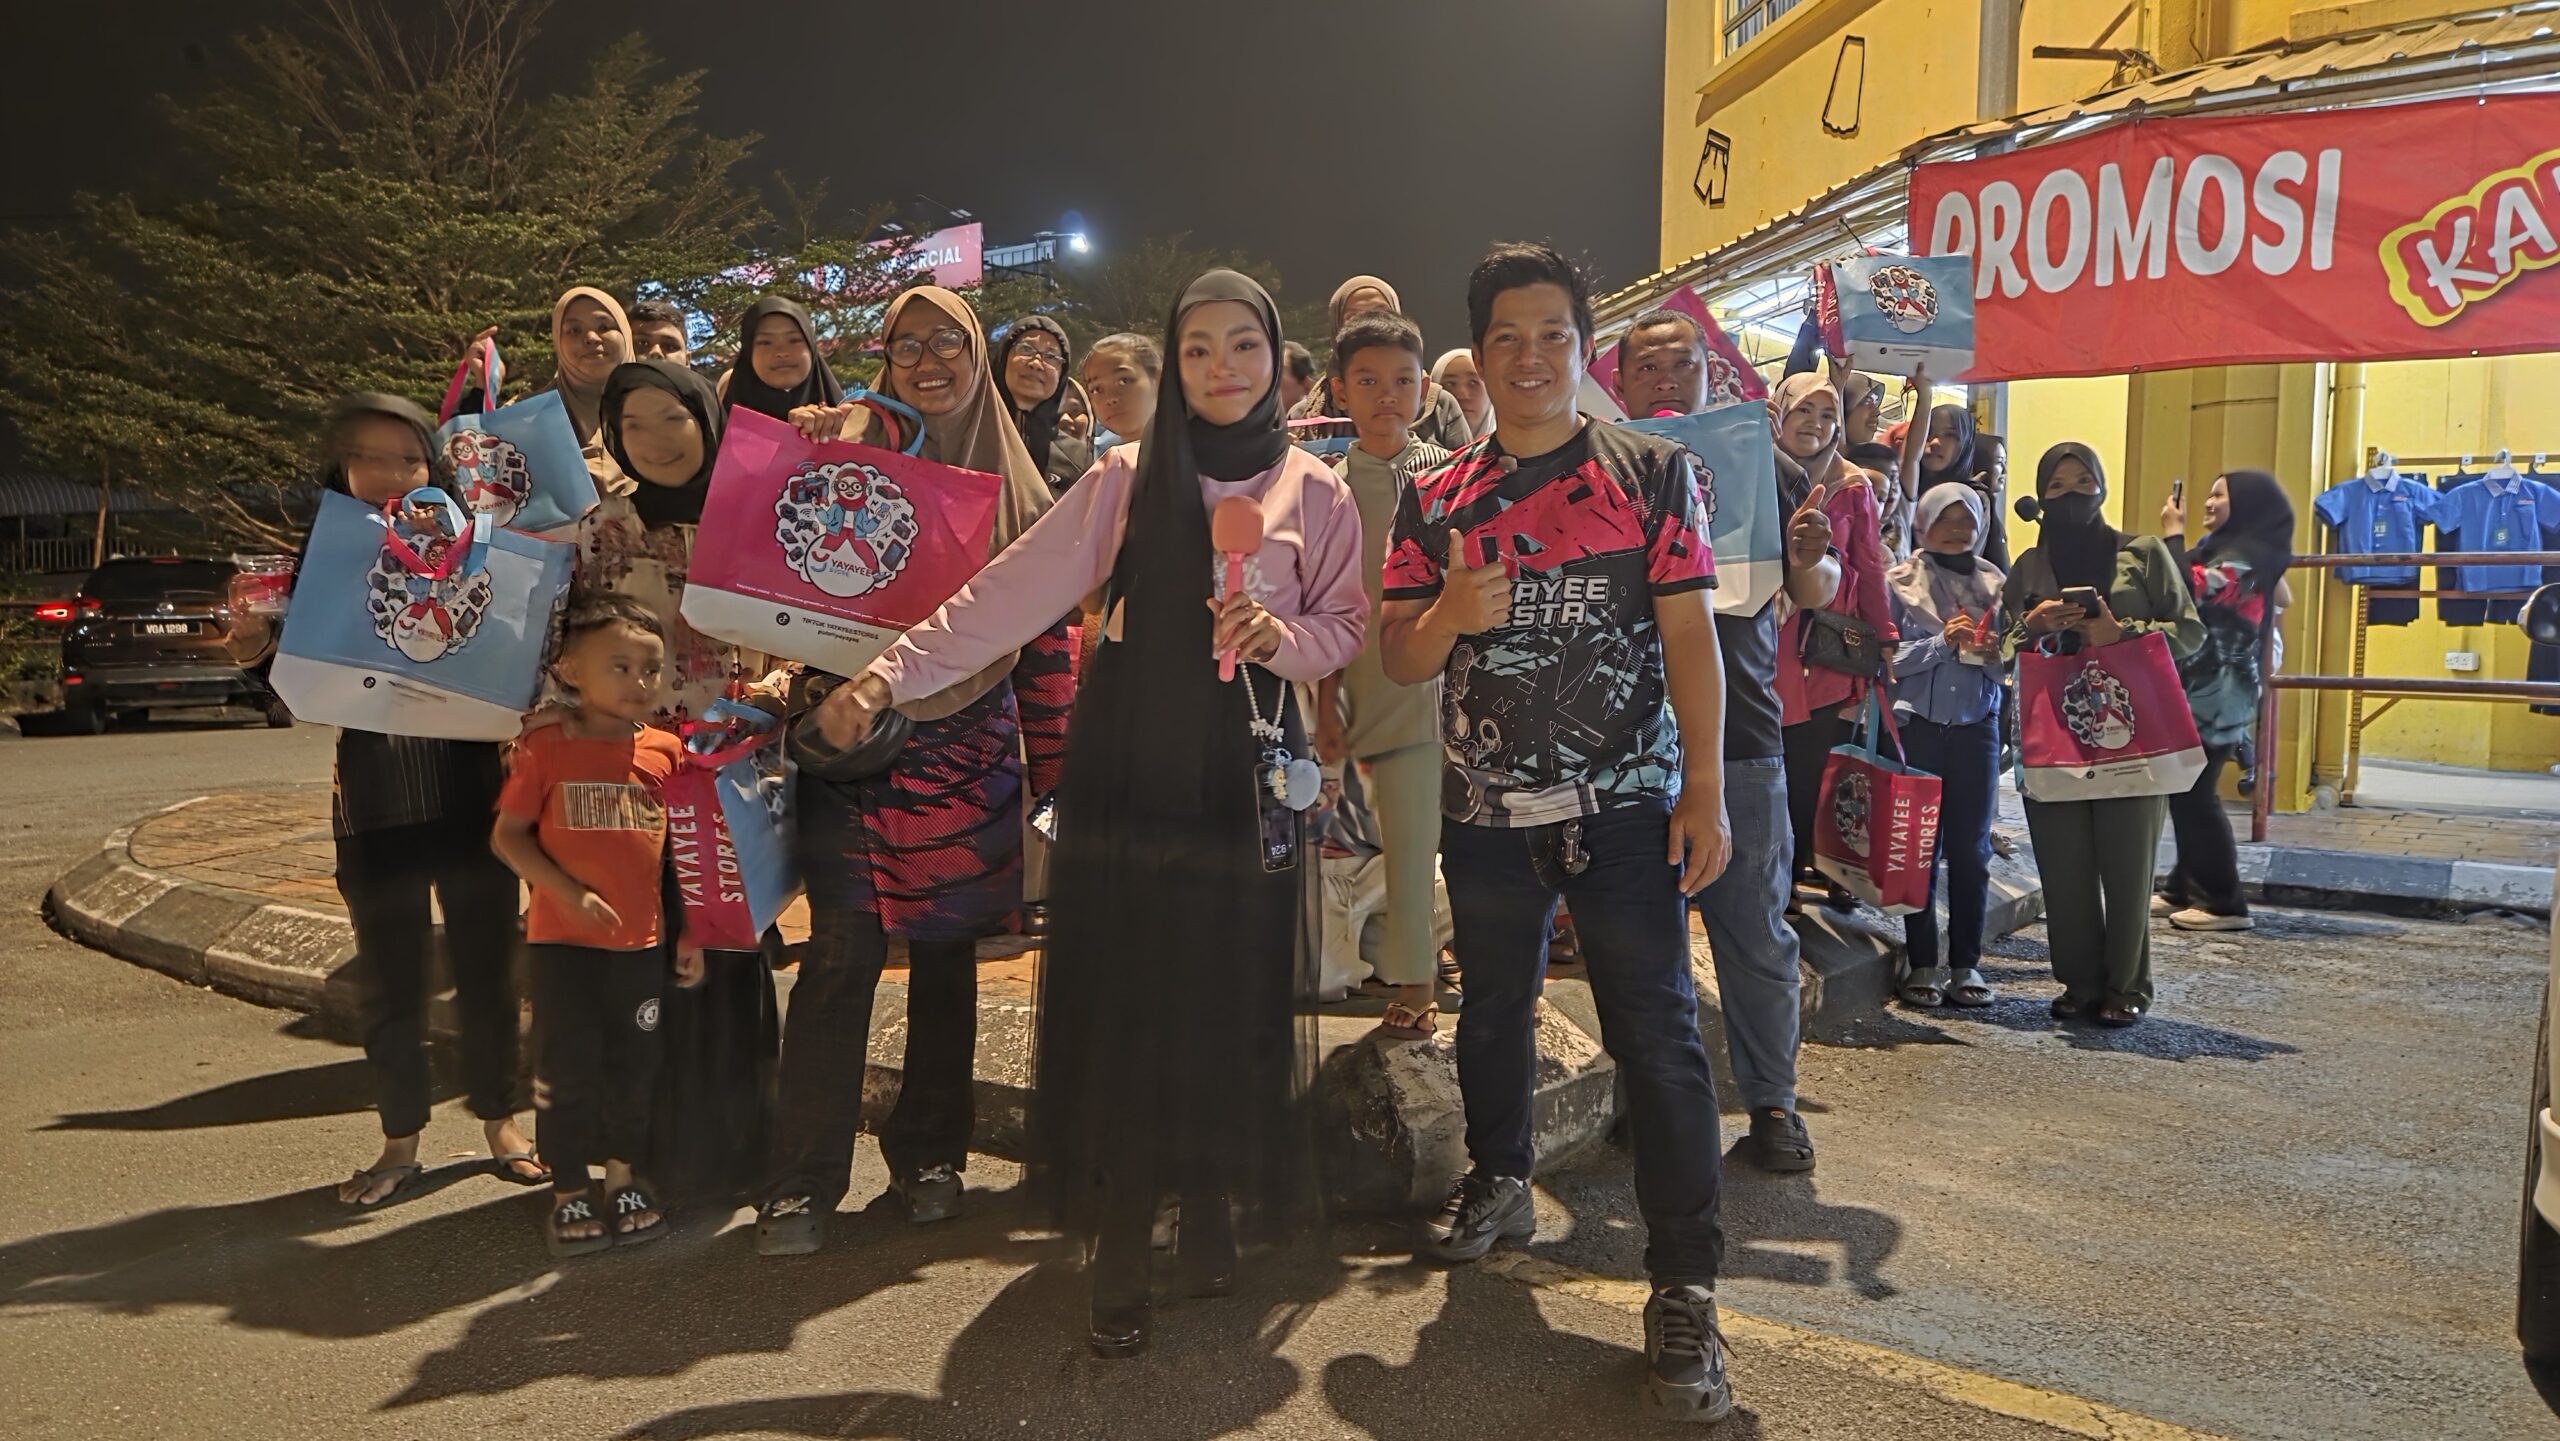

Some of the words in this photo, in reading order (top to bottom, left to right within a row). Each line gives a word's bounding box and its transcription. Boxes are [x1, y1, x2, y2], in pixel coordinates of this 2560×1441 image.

[2416, 166, 2560, 309] KA
[669, 805, 704, 906] YAYAYEE
[1887, 798, 1910, 872] YAYAYEE
[1918, 805, 1938, 869] STORES
